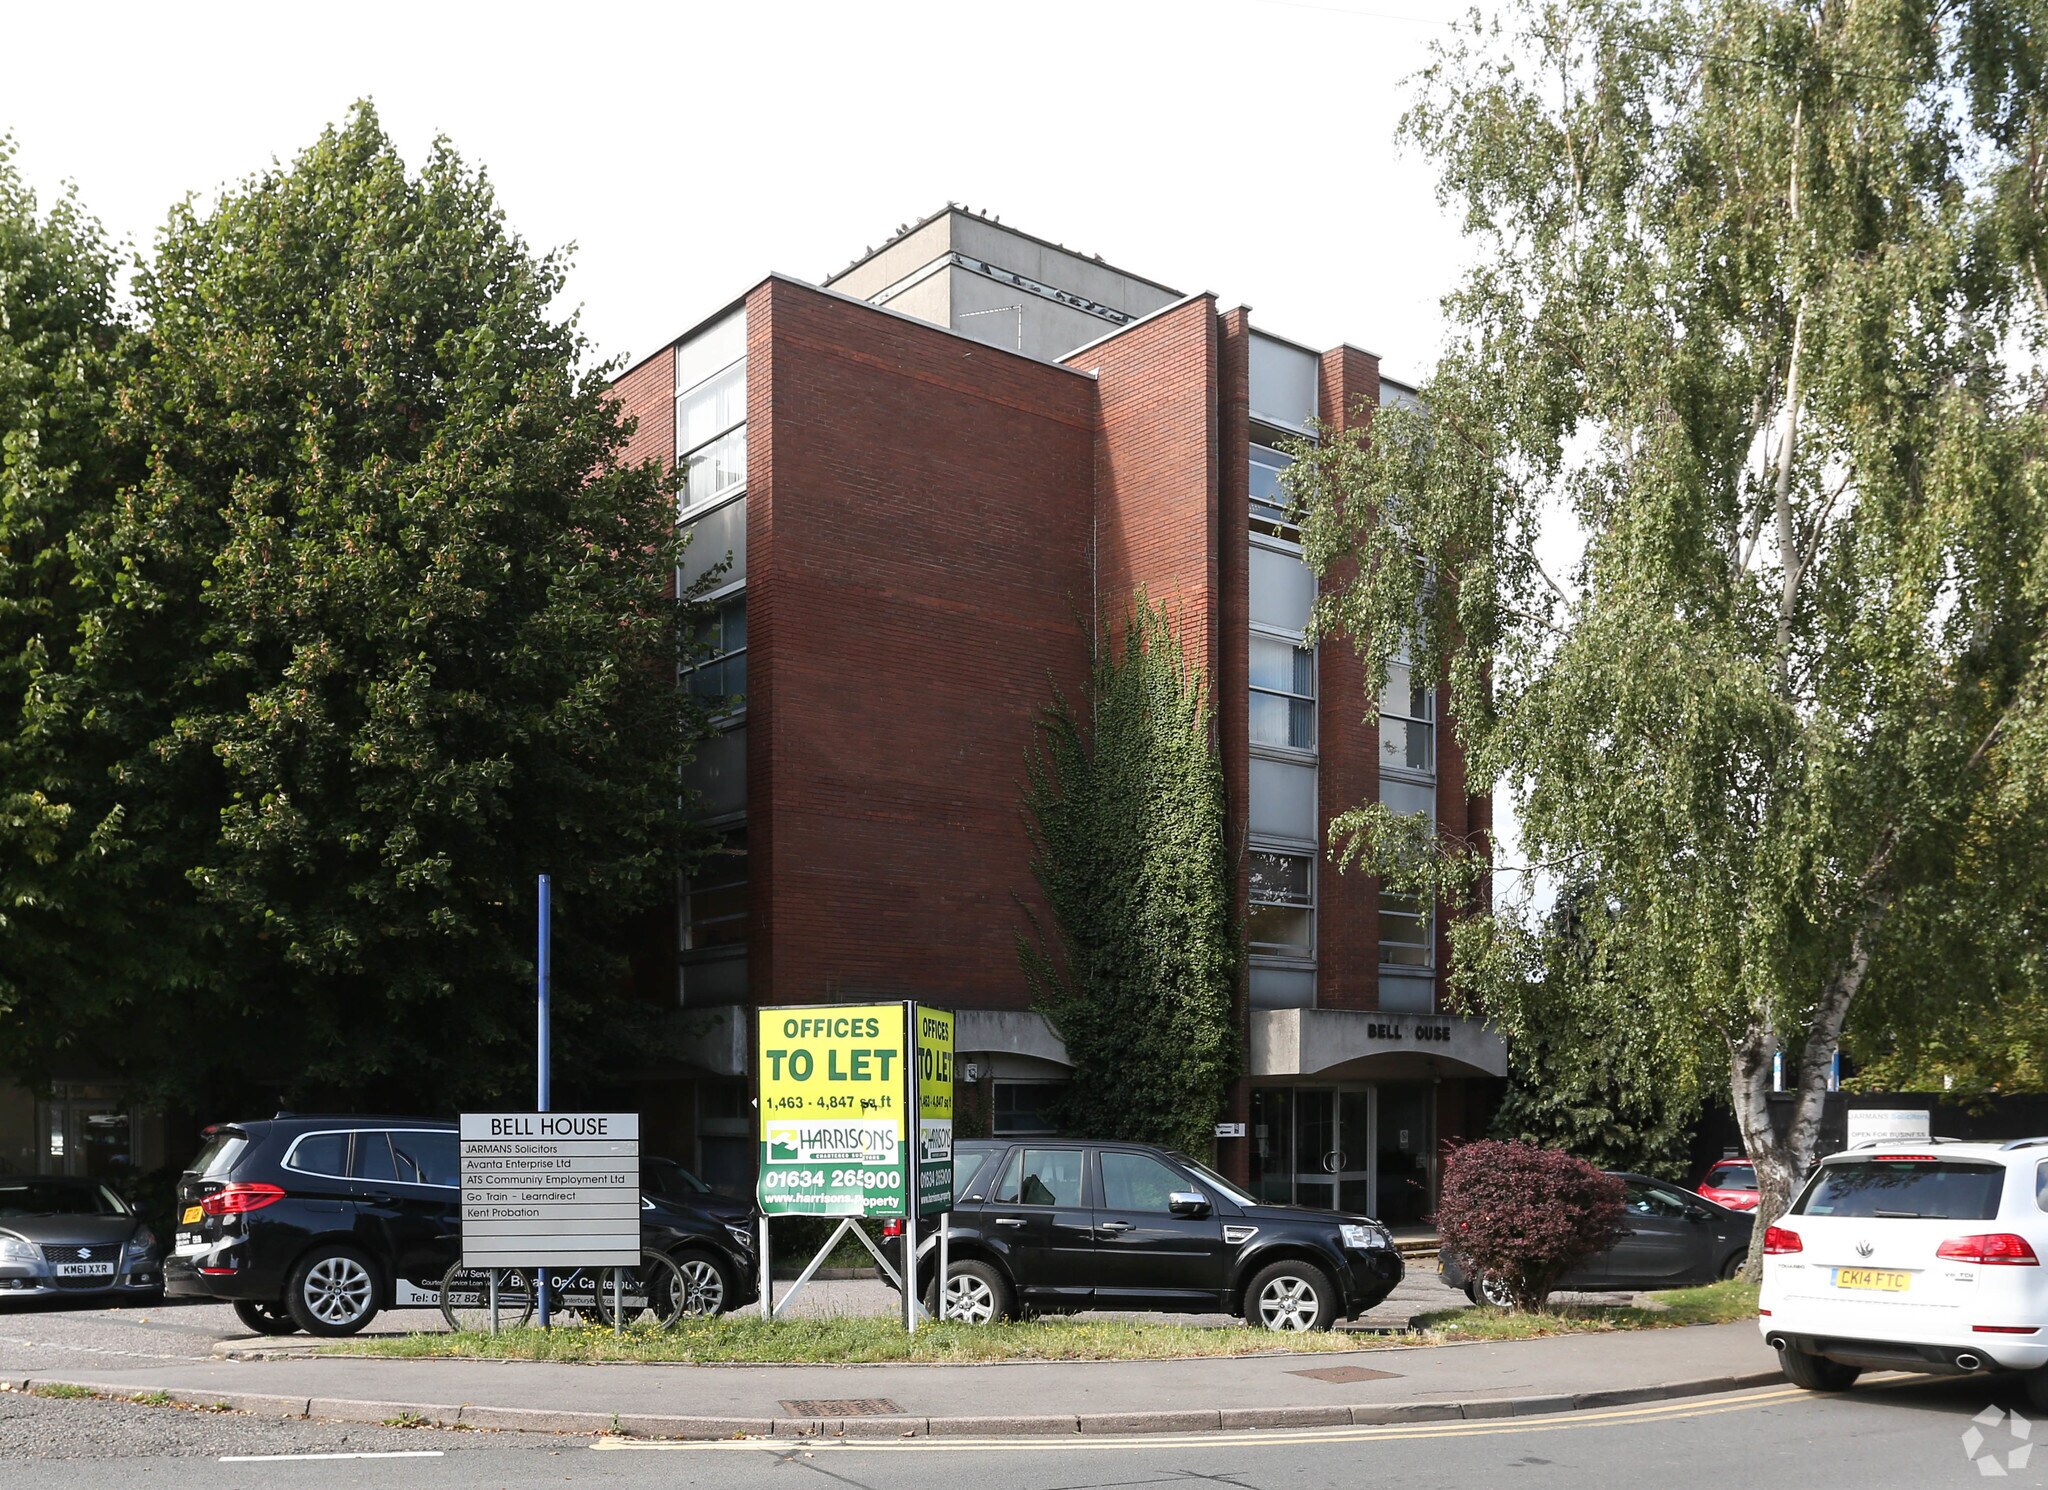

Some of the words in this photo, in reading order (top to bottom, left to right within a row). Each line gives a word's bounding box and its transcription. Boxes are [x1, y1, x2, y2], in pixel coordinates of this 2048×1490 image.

[783, 1017, 880, 1039] OFFICES
[922, 1017, 949, 1041] OFFICES
[1367, 1023, 1402, 1039] BELL
[766, 1048, 814, 1081] TO
[828, 1049, 897, 1081] LET
[918, 1047, 932, 1081] TO
[936, 1050, 952, 1083] LET
[767, 1096, 803, 1111] 1,463
[817, 1096, 854, 1110] 4,847
[880, 1095, 892, 1107] ft
[1848, 1112, 1889, 1120] JARMANS
[491, 1118, 534, 1136] BELL
[541, 1117, 608, 1135] HOUSE
[799, 1128, 895, 1151] HARRISONS
[466, 1145, 512, 1154] JARMANS
[514, 1144, 558, 1154] Solicitors
[466, 1160, 503, 1169] Avanta
[505, 1159, 554, 1170] Enterprise
[556, 1158, 571, 1168] Ltd
[466, 1175, 483, 1184] ATS
[545, 1174, 608, 1186] Employment
[610, 1174, 625, 1184] Ltd
[765, 1170, 825, 1188] 01634
[830, 1168, 901, 1189] 265900
[466, 1192, 482, 1201] Go
[486, 1192, 508, 1201] Train
[521, 1191, 576, 1201] Learndirect
[764, 1192, 900, 1209] www.harrisons.poperty
[467, 1208, 490, 1217] Kent
[492, 1208, 540, 1217] Probation
[63, 1265, 86, 1274] KM61
[89, 1265, 108, 1274] XXR
[470, 1269, 491, 1279] Servic
[1841, 1270, 1871, 1286] CK14
[1875, 1272, 1904, 1288] FTC
[410, 1293, 428, 1303] Tel:
